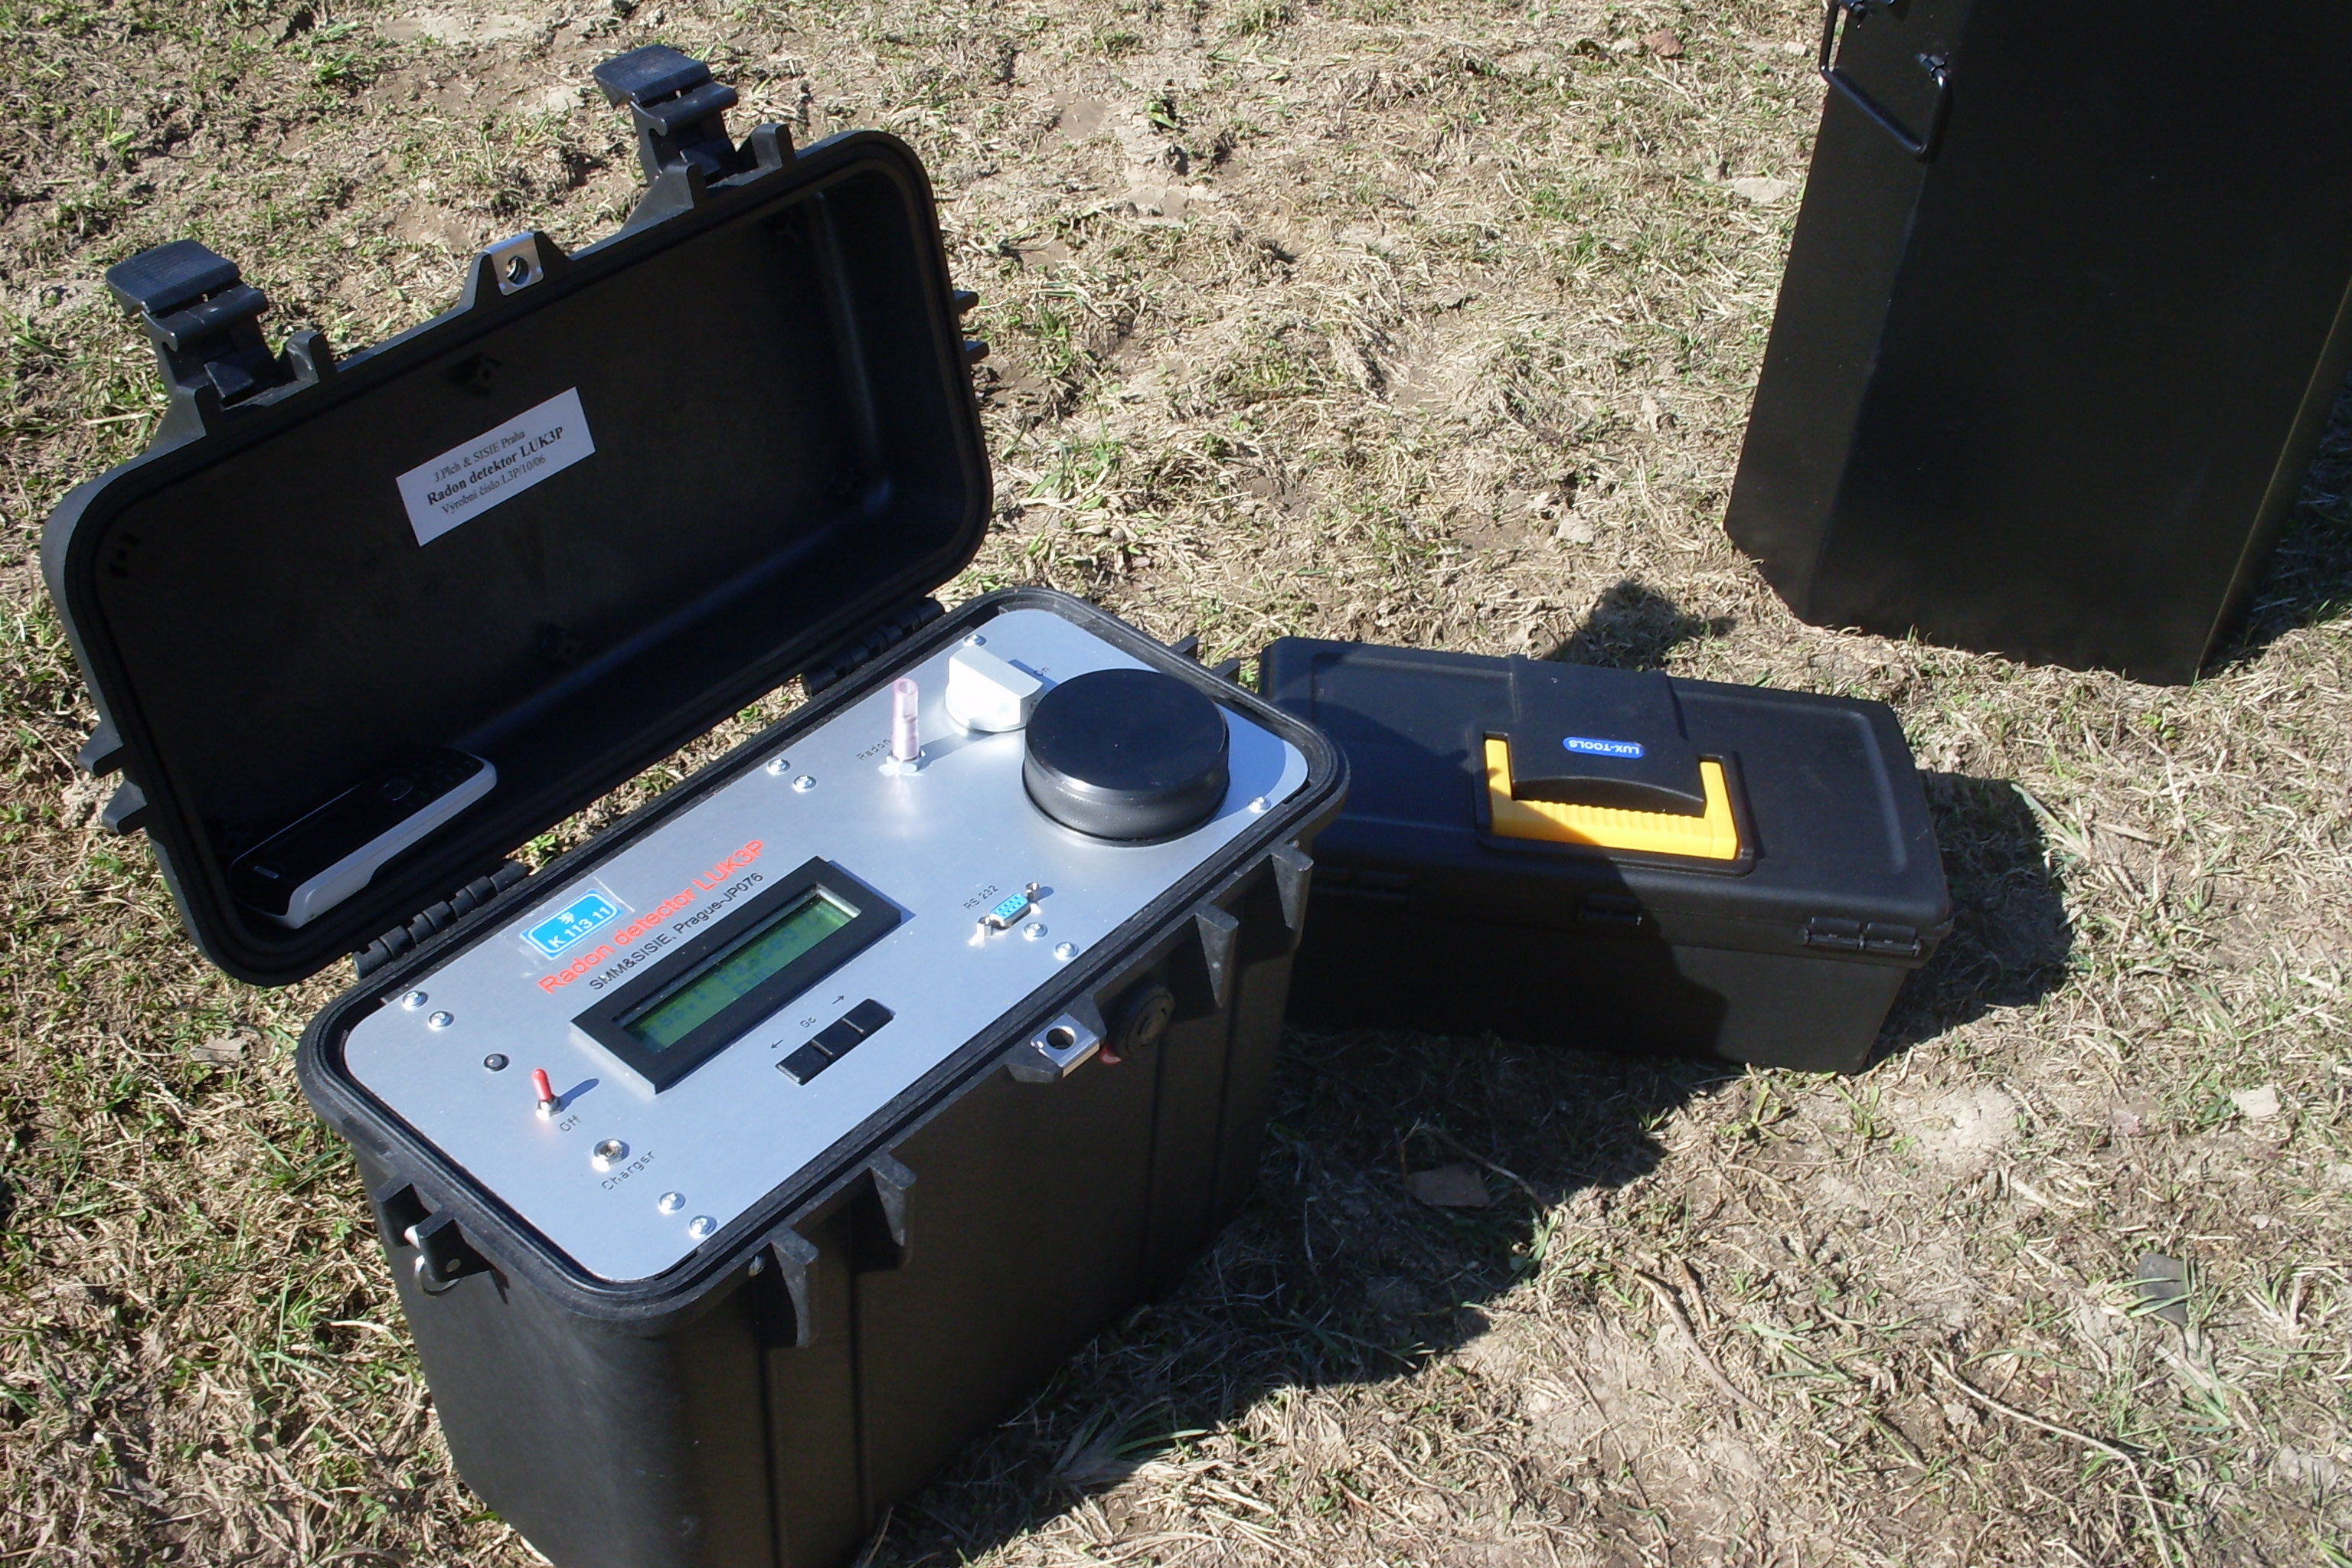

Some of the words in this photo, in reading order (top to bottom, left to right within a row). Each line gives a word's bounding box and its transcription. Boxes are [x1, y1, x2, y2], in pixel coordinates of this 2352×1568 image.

[426, 479, 467, 505] Radon
[469, 453, 518, 484] detektor
[521, 426, 564, 457] LUK3P
[463, 457, 472, 468] &
[473, 443, 500, 462] SISIE
[501, 430, 525, 449] Praha
[1568, 740, 1640, 755] LUX-TOOLS
[537, 943, 616, 994] Radon
[614, 887, 697, 946] detector
[692, 839, 764, 891] LUK3P
[673, 873, 763, 934] Prague-JP076
[963, 898, 980, 910] RS
[978, 885, 998, 900] 232
[547, 935, 567, 949] K
[564, 918, 593, 938] 113
[592, 906, 611, 920] 11
